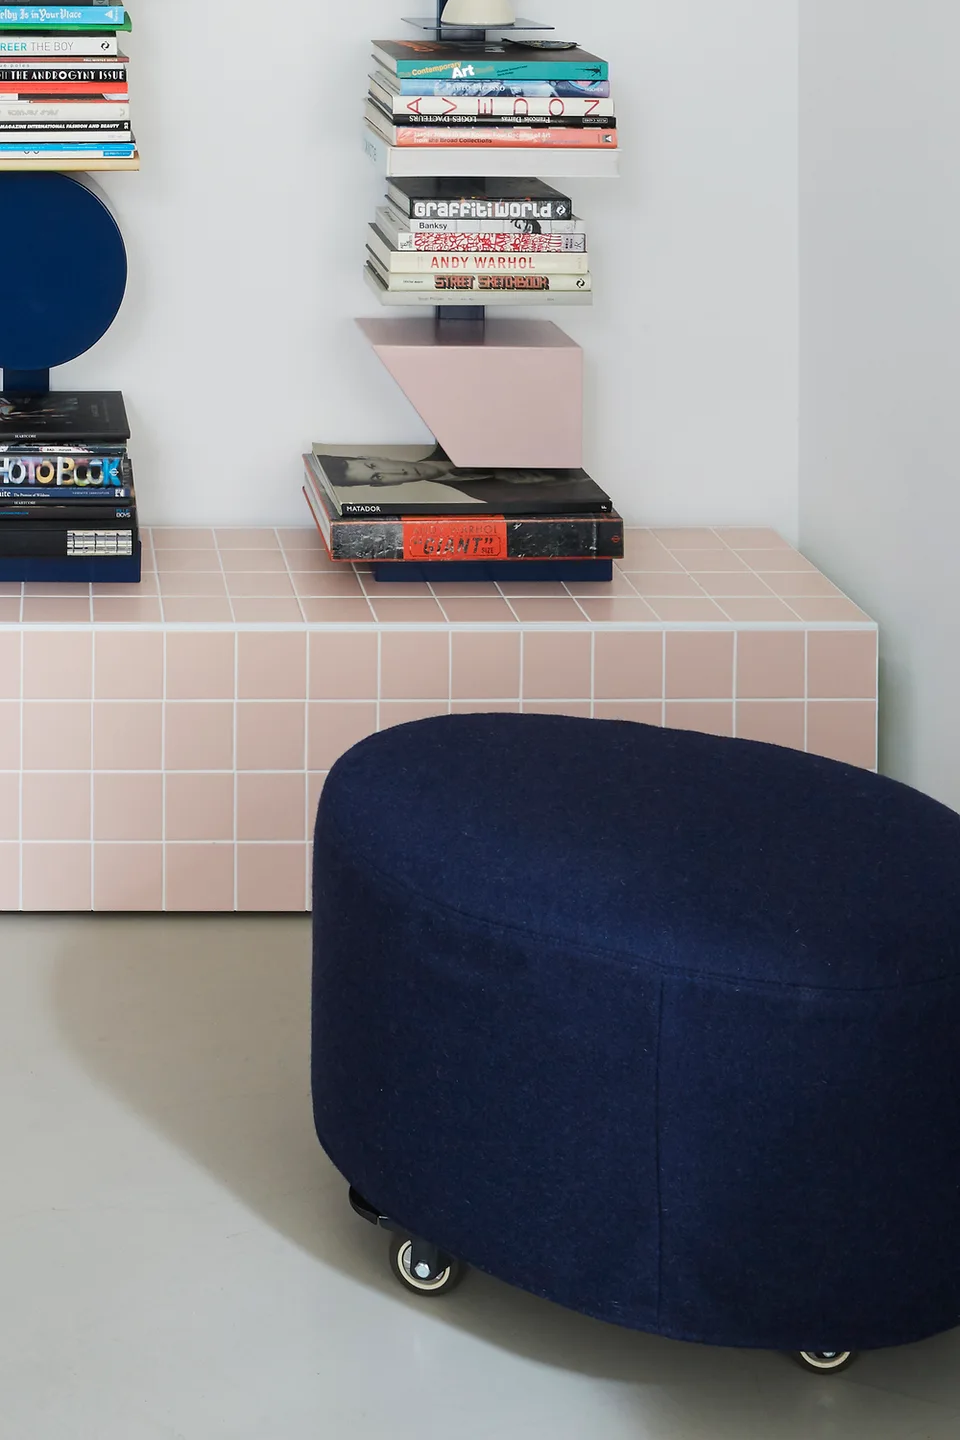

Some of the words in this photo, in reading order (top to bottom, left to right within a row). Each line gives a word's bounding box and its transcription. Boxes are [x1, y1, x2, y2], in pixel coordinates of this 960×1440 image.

[20, 8, 29, 19] Is
[31, 9, 39, 19] in
[39, 9, 59, 22] Your
[60, 9, 81, 19] Place
[31, 42, 50, 51] THE
[54, 42, 74, 51] BOY
[11, 71, 28, 80] THE
[31, 71, 95, 80] ANDROGYNY
[100, 71, 124, 80] ISSUE
[412, 62, 462, 76] Contemporary
[452, 64, 475, 79] Art
[472, 83, 505, 91] PICASSO
[406, 98, 600, 116] AVEDON
[431, 256, 469, 268] ANDY
[474, 257, 535, 268] WARHOL
[434, 275, 476, 290] STREET
[478, 276, 549, 290] SKETCHBOOK
[413, 526, 442, 534] ANDY
[452, 525, 498, 533] WARHOL
